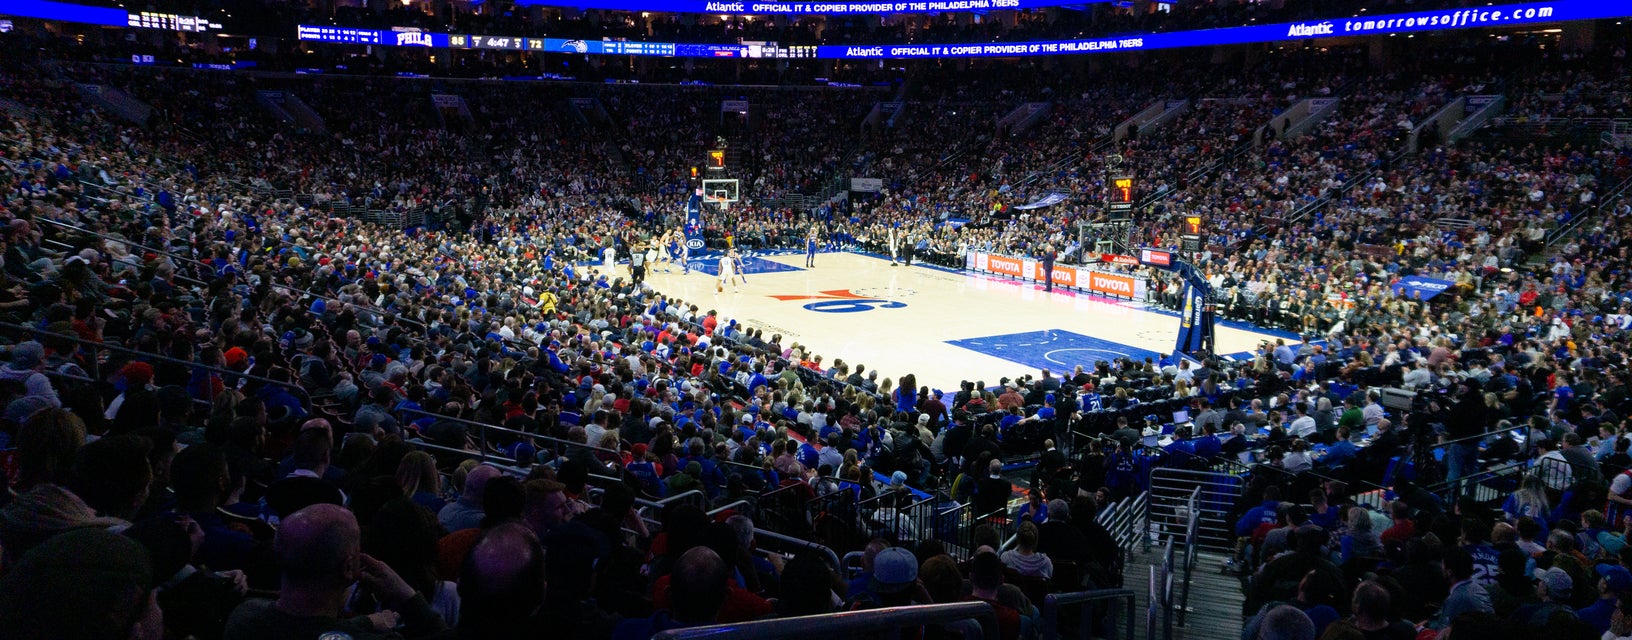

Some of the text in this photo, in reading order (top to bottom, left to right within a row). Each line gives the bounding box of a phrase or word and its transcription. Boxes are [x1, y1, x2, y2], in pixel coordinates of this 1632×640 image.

[706, 2, 744, 12] Atlantic
[752, 3, 792, 12] OFFICIAL
[794, 4, 804, 12] IT
[805, 4, 812, 12] &
[814, 4, 848, 12] COPIER
[850, 3, 894, 12] PROVIDER
[894, 2, 908, 10] OF
[908, 2, 926, 10] THE
[928, 0, 990, 9] PHILADELPHIA
[1344, 6, 1552, 32] tomorrowsoffice.com
[1288, 21, 1334, 36] Atlantic
[397, 32, 432, 47] PHILA
[451, 36, 464, 45] 85
[487, 38, 509, 47] 4:47
[530, 40, 542, 48] 72
[846, 46, 884, 56] Atlantic
[890, 38, 1144, 56] OFFICIAL IT & COPIER PROVIDER OF THE PHILADELPHIA 76ERS
[990, 259, 1020, 273] TOYOTA
[1040, 267, 1072, 282] TYOTA
[1094, 277, 1130, 292] TOYOTA
